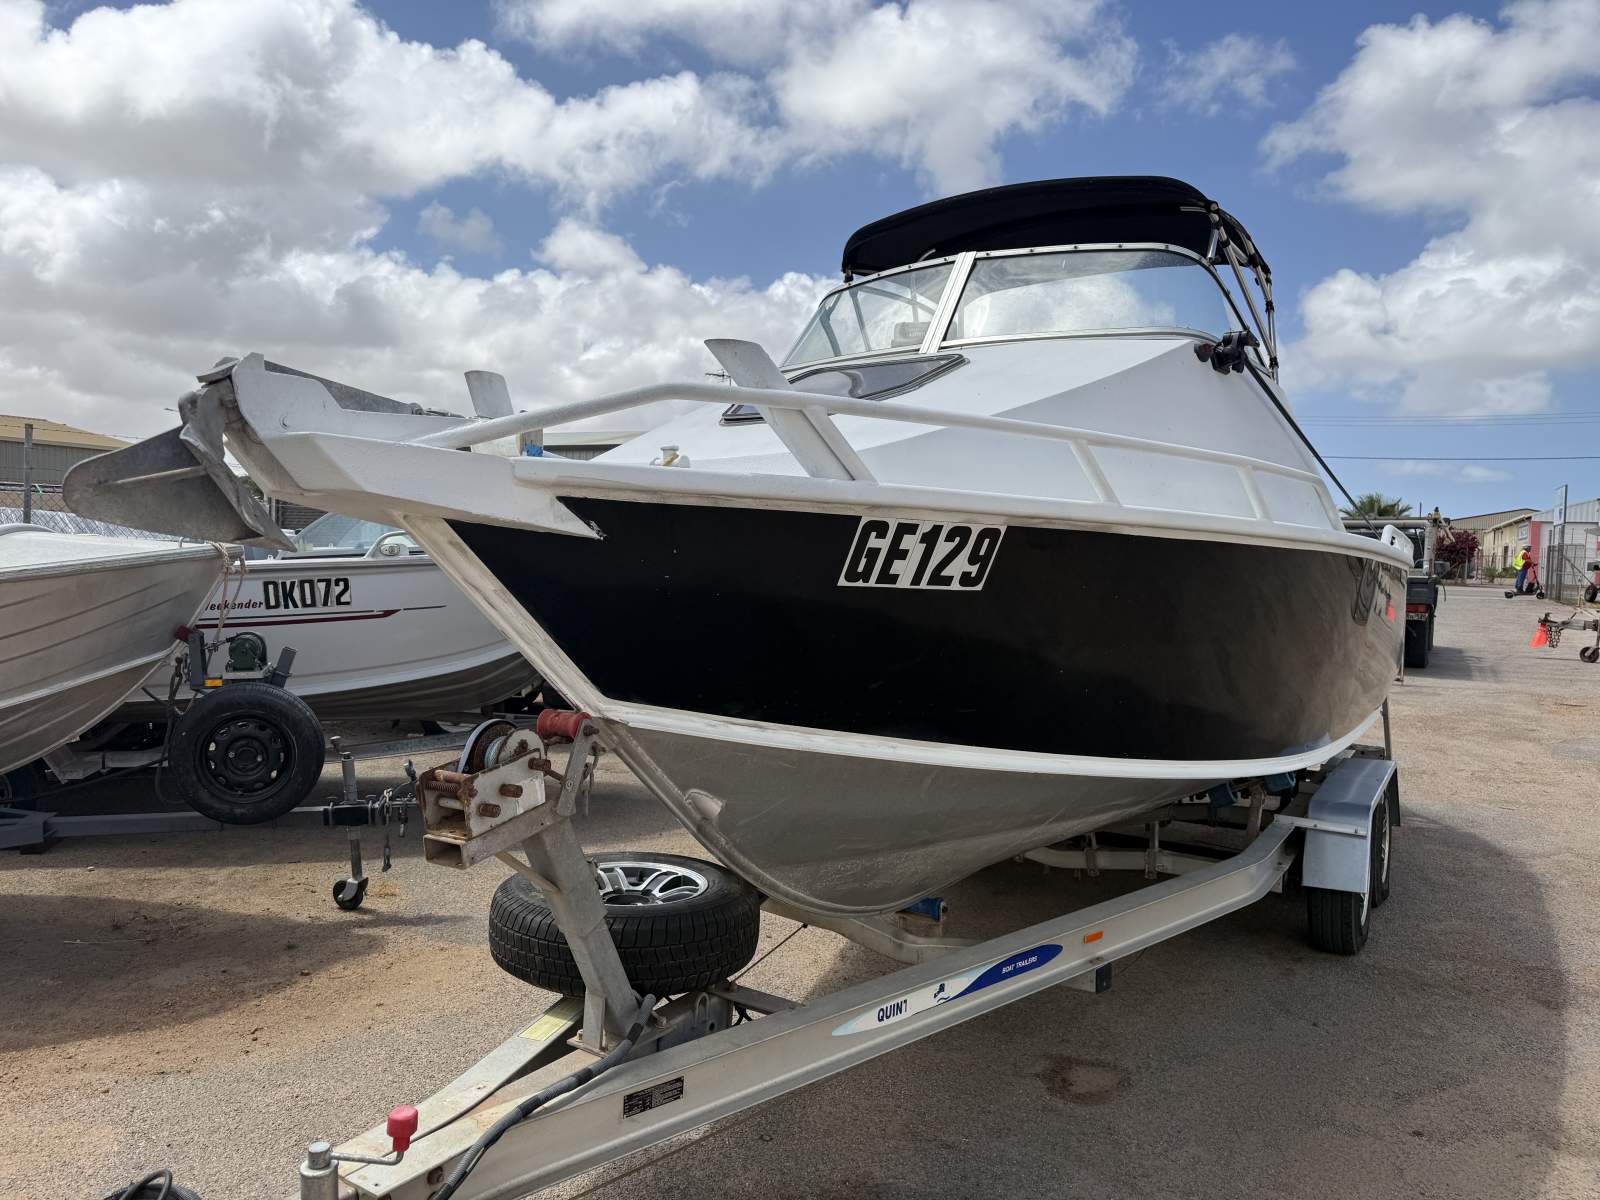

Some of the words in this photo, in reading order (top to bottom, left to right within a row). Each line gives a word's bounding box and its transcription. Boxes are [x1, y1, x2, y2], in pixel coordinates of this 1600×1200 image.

[844, 519, 1002, 588] GE129
[263, 577, 351, 610] DK072
[1002, 963, 1015, 974] BOAT
[1016, 955, 1038, 969] TRAILERS
